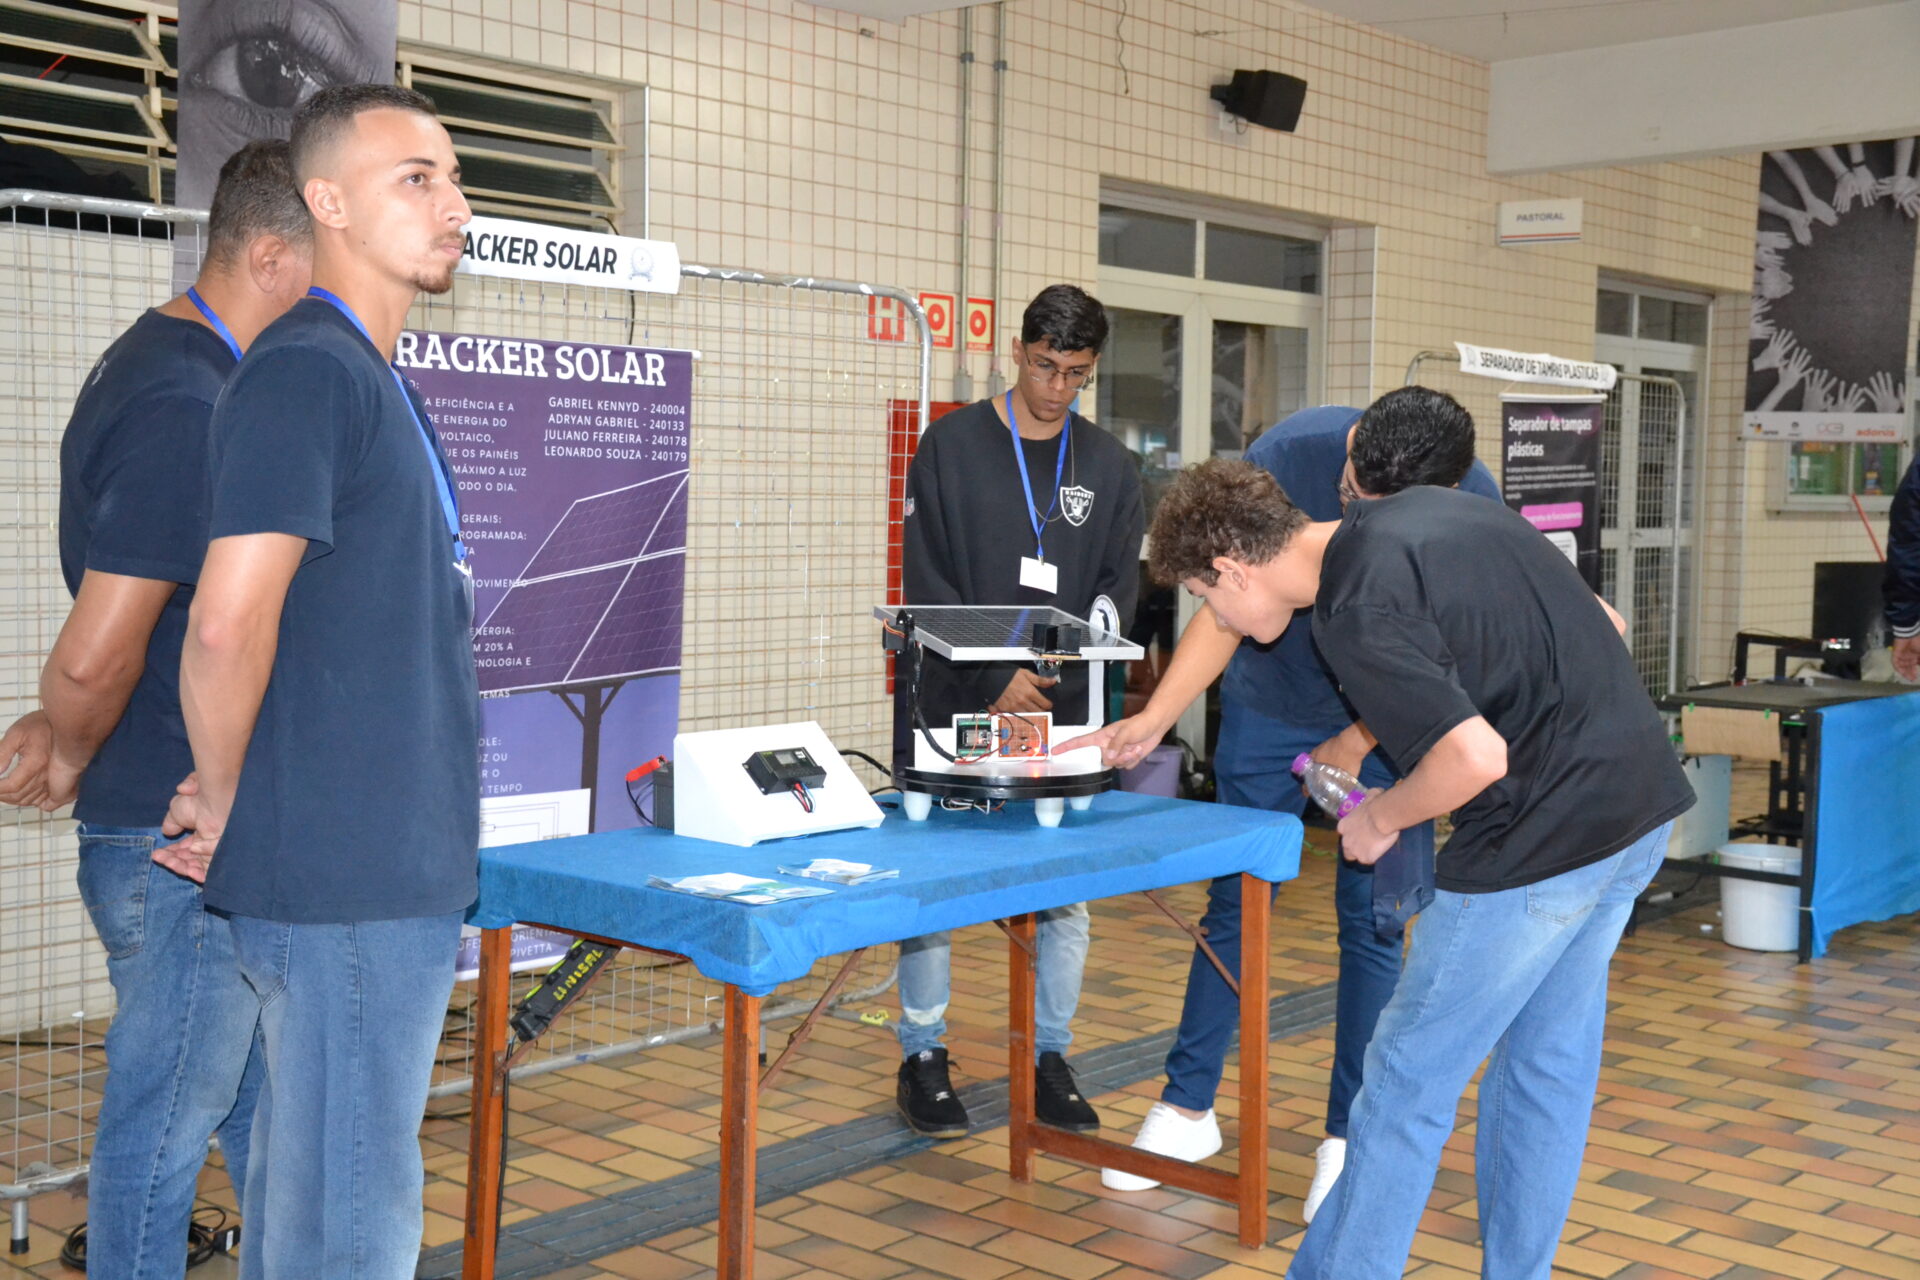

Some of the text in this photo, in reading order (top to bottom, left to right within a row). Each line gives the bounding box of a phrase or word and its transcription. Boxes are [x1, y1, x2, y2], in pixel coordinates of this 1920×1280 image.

[1516, 212, 1565, 222] PASTORAL
[463, 231, 617, 274] ACKER SOLAR
[395, 332, 667, 387] RACKER SOLAR
[1480, 352, 1524, 373] SEPARADOR
[1526, 359, 1537, 375] DE
[1537, 361, 1563, 379] TAMPAS
[424, 397, 515, 411] A EFICIÊNCIA E A
[548, 397, 593, 410] GABRIEL
[597, 400, 640, 412] KENNYD
[650, 403, 685, 415] 240004
[444, 414, 489, 426] ENERGIA
[493, 418, 507, 427] DO
[548, 413, 591, 426] ADRYAN
[595, 416, 639, 429] GABRIEL
[649, 419, 684, 431] 240133
[1508, 416, 1592, 435] Separador de tampas
[440, 432, 495, 443] VOLTAICO,
[544, 429, 589, 442] JULIANO
[593, 431, 642, 444] FERREIRA
[652, 435, 687, 447] 240178
[462, 449, 476, 458] OS
[480, 449, 519, 460] PAINÉIS
[544, 446, 602, 458] LEONARDO
[606, 448, 642, 460] SOUZA
[651, 451, 687, 462] 240179
[1508, 441, 1544, 461] plásticas
[453, 464, 527, 477] MÁXIMO A LUZ
[459, 481, 517, 492] ODO O DIA.
[462, 514, 502, 524] GERAIS:
[460, 531, 527, 541] ROGRAMADA:
[484, 643, 504, 652] 20%
[507, 642, 514, 651] A
[526, 656, 532, 666] E
[493, 753, 508, 762] OU
[492, 769, 500, 778] O
[488, 783, 523, 794] TEMPO
[553, 950, 604, 1001] UNISAL
